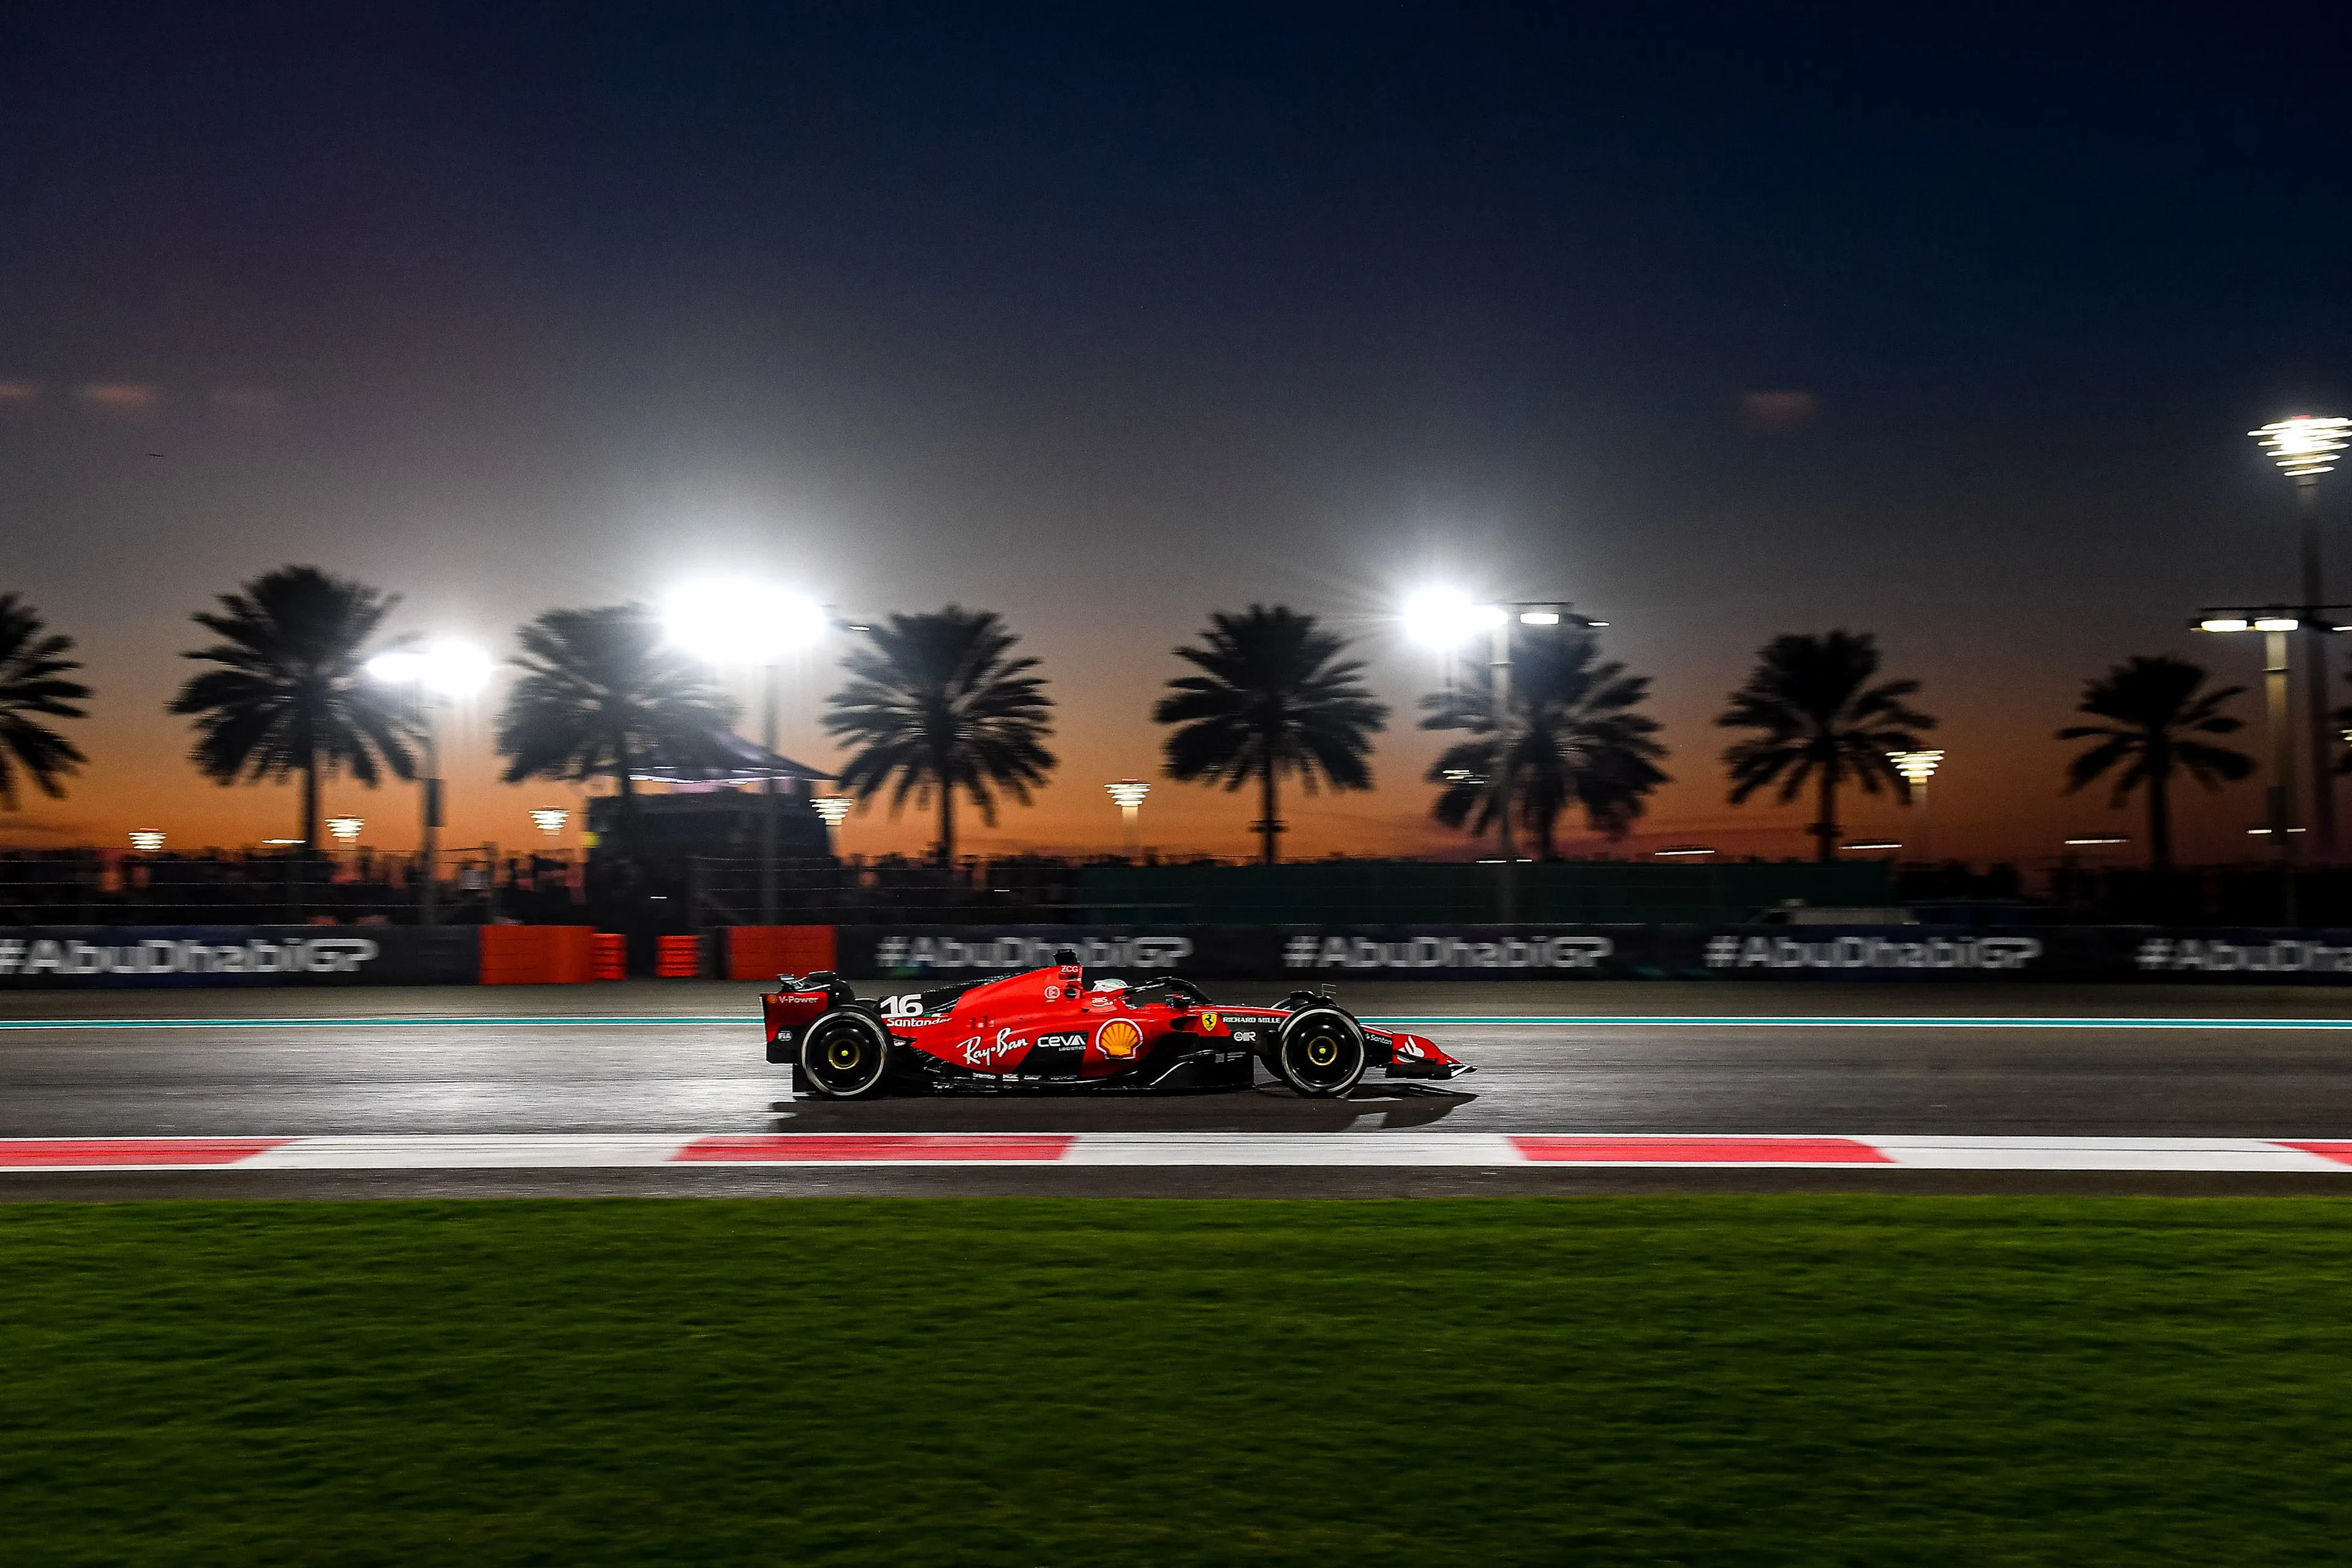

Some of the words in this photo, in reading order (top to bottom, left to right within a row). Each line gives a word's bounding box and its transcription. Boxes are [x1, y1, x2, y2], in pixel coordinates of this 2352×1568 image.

[1283, 936, 1613, 967] #AbuDhabiGP
[1703, 936, 2043, 968] #AbuDhabiGP
[880, 993, 923, 1018] 16
[886, 1018, 952, 1027] Santander
